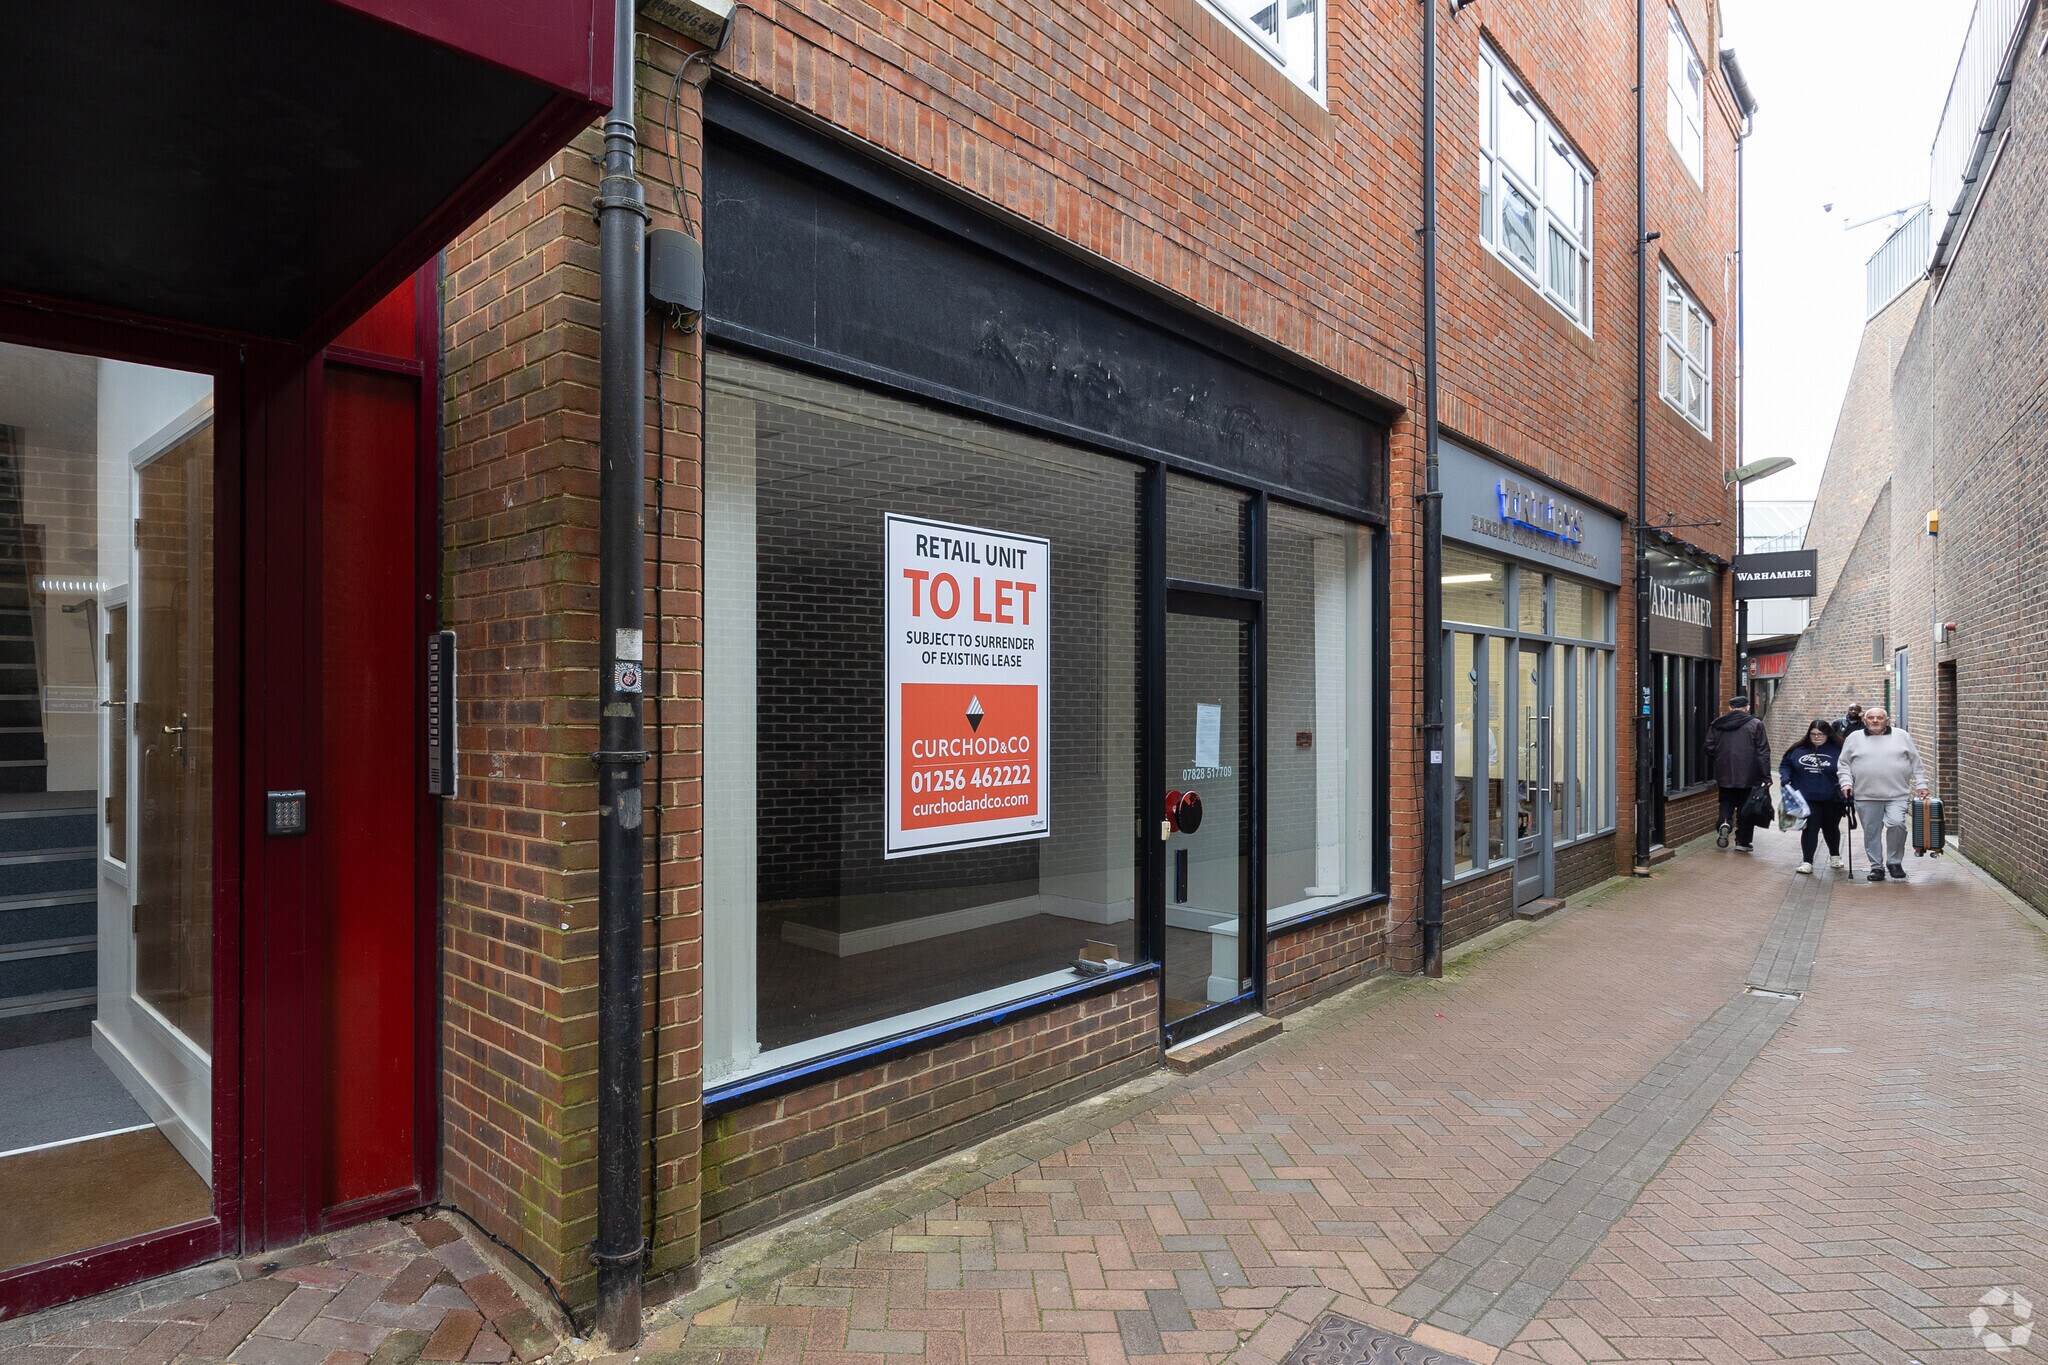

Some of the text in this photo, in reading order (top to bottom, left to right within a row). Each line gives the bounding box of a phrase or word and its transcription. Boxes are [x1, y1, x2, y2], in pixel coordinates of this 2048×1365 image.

[677, 11, 701, 27] 616
[1500, 479, 1585, 543] TRILBYS
[1471, 515, 1511, 543] BARBER
[916, 533, 1028, 570] RETAIL UNIT
[1737, 570, 1812, 581] WARHAMMER
[903, 568, 1037, 626] TO LET
[1649, 576, 1711, 628] ARHAMMER
[906, 630, 1035, 650] SUBJECT TO SURRENDER
[921, 651, 1022, 667] OF EXISTING LEASE
[1758, 653, 1788, 675] WIMPY
[911, 736, 1030, 759] CURCHOD&CO
[911, 764, 1031, 794] 01256 462222
[1182, 766, 1232, 781] 07828 517709
[912, 793, 1029, 817] curchodandco.com
